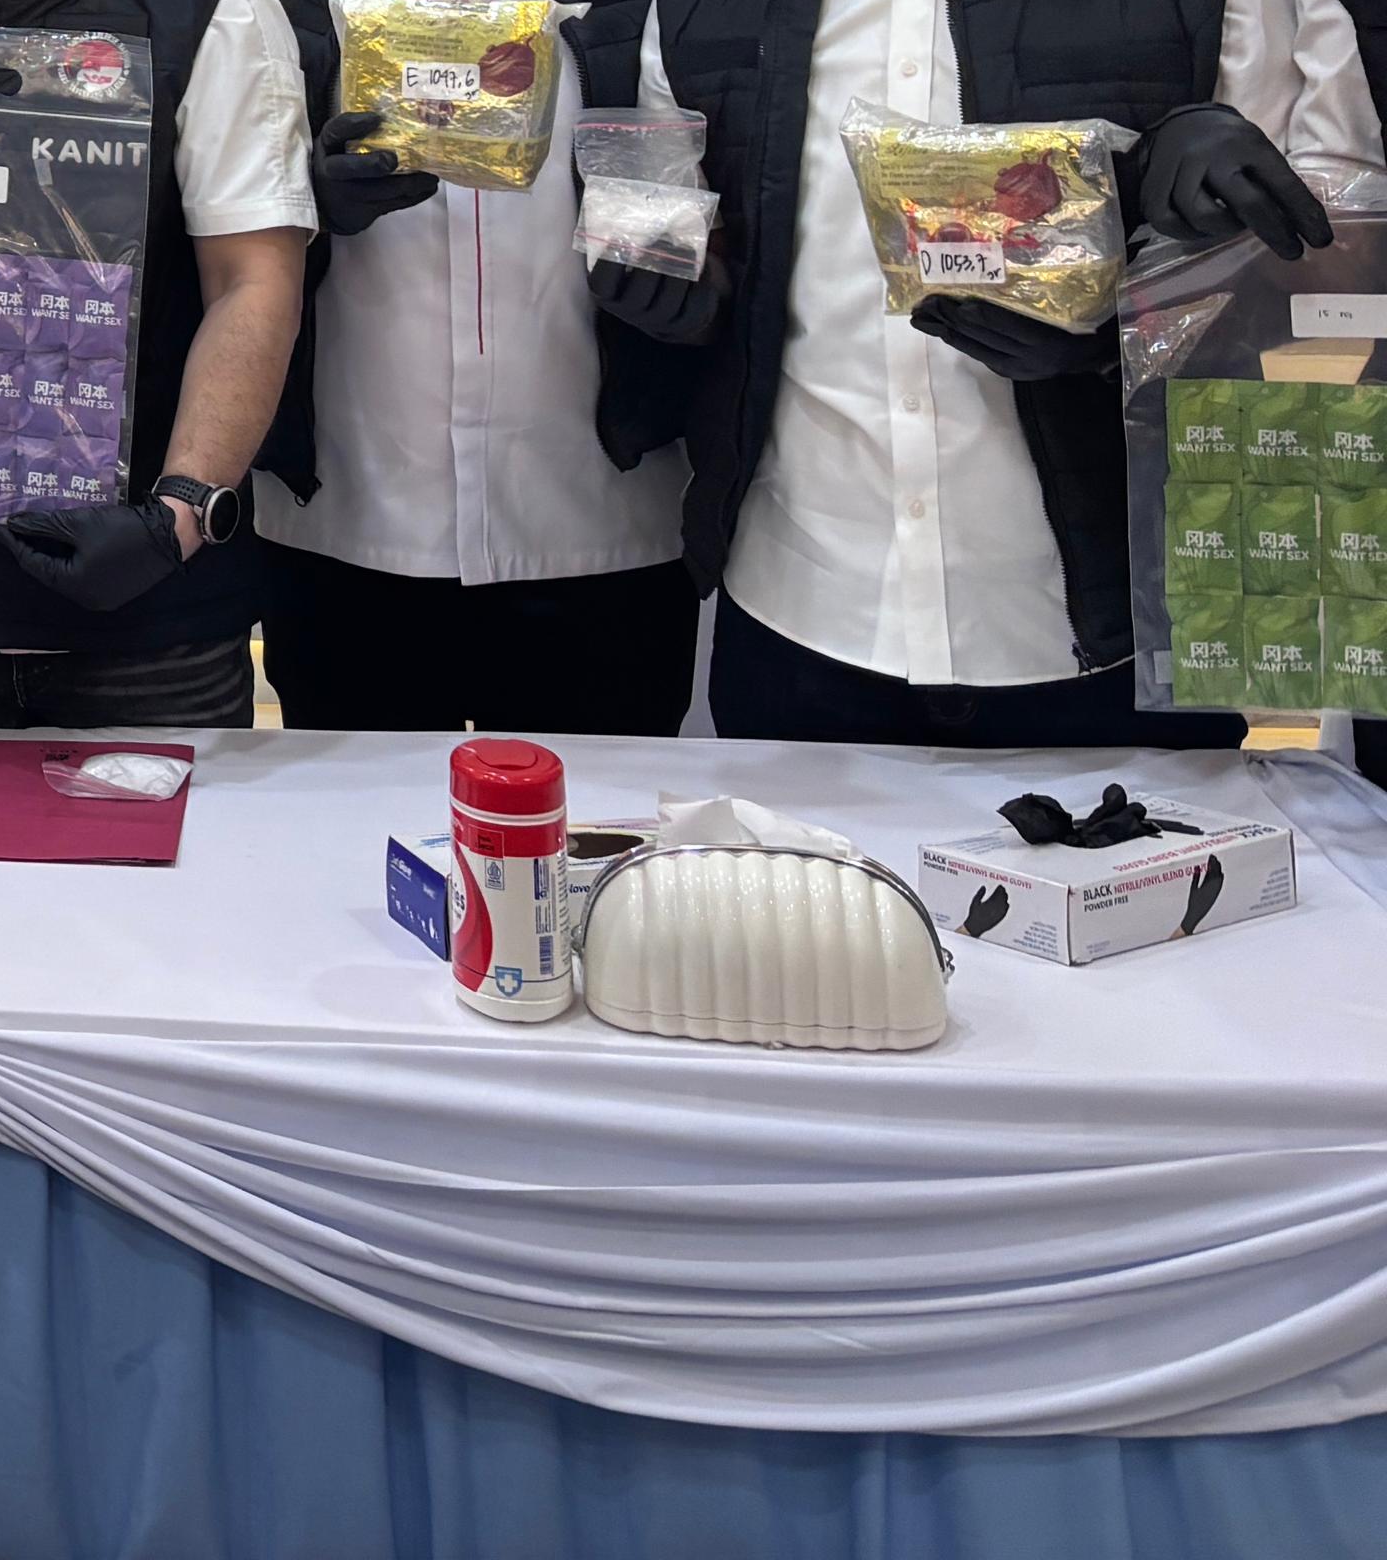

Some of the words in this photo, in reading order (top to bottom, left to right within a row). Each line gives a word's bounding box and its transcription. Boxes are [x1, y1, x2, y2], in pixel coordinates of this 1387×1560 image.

[407, 67, 418, 88] E
[32, 137, 148, 167] KANIT
[85, 299, 115, 315] 冈本
[75, 313, 102, 325] WANT
[104, 316, 123, 326] SEX
[5, 389, 21, 398] SEX
[79, 383, 108, 400] 冈本
[70, 396, 96, 408] WANT
[97, 399, 115, 410] SEX
[1186, 425, 1225, 443] 冈本
[1258, 429, 1298, 446] 冈本
[1335, 431, 1374, 450] 冈本
[1175, 443, 1211, 453] WANT
[1213, 442, 1236, 453] SEX
[1248, 446, 1282, 457] WANT
[1283, 447, 1308, 456] SEX
[1323, 448, 1359, 461] WANT
[1361, 452, 1385, 462] SEX
[1, 483, 17, 492] SEX
[62, 489, 89, 501] WANT
[90, 493, 108, 502] SEX
[1185, 530, 1225, 548] 冈本
[1259, 531, 1298, 549] 冈本
[1341, 532, 1380, 550] 冈本
[1175, 546, 1212, 559] WANT
[1213, 549, 1235, 559] SEX
[1249, 548, 1284, 560] WANT
[1286, 550, 1309, 561] SEX
[1330, 549, 1367, 561] WANT
[1369, 551, 1387, 562] SEX
[1190, 641, 1229, 658] 冈本
[1262, 645, 1303, 662] 冈本
[1345, 645, 1384, 665] 冈本
[1180, 657, 1215, 669] WANT
[1217, 658, 1239, 668] SEX
[1254, 661, 1287, 673] WANT
[1290, 662, 1313, 672] SEX
[1371, 666, 1387, 676] SE
[924, 852, 947, 865] BLACK
[1083, 883, 1113, 902] BLACK
[1162, 868, 1184, 882] BLEND
[1084, 896, 1114, 912] POWDER
[1114, 894, 1129, 905] FREE
